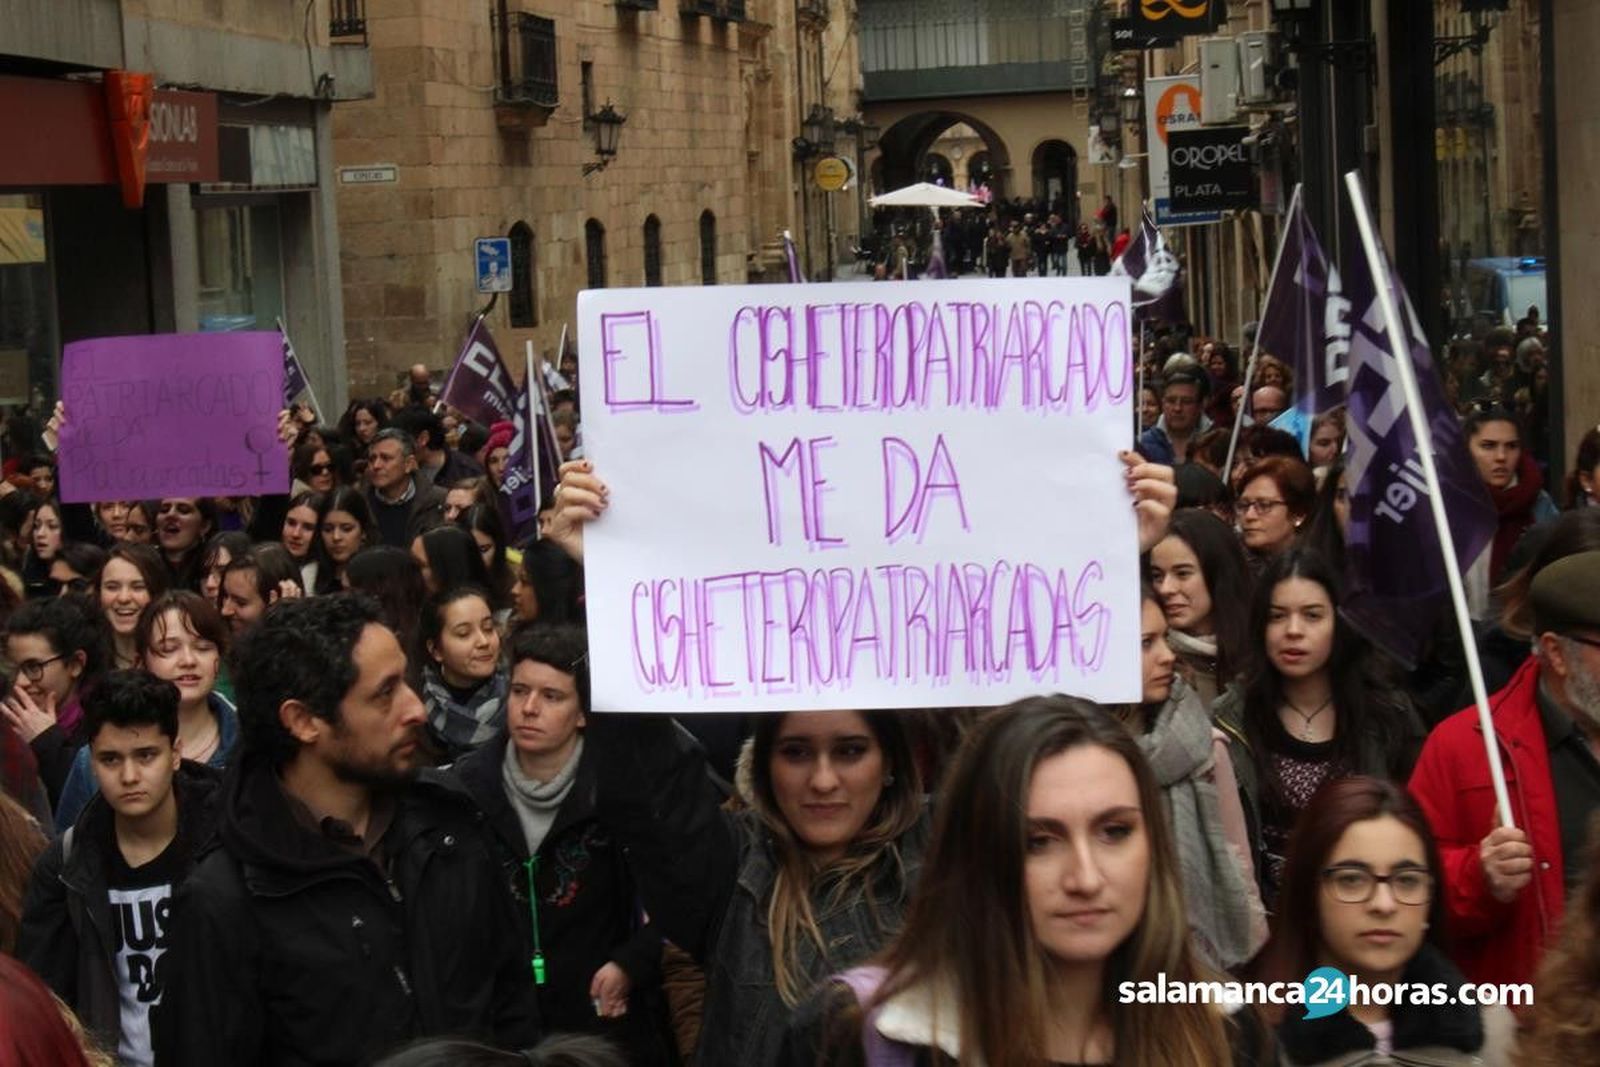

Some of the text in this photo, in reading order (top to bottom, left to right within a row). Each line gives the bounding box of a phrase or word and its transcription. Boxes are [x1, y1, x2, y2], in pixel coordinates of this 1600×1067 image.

[1158, 111, 1201, 125] OSRA
[1171, 144, 1247, 170] OROPEL
[1174, 183, 1223, 197] PLATA
[601, 310, 699, 414] EL
[729, 301, 1132, 416] CISHETEROPATRIARCADO
[66, 370, 273, 418] PATRIARCADO
[758, 434, 972, 552] ME DA
[630, 560, 1112, 697] CISHETEROPATRIARCADAS
[111, 896, 172, 951] JUS
